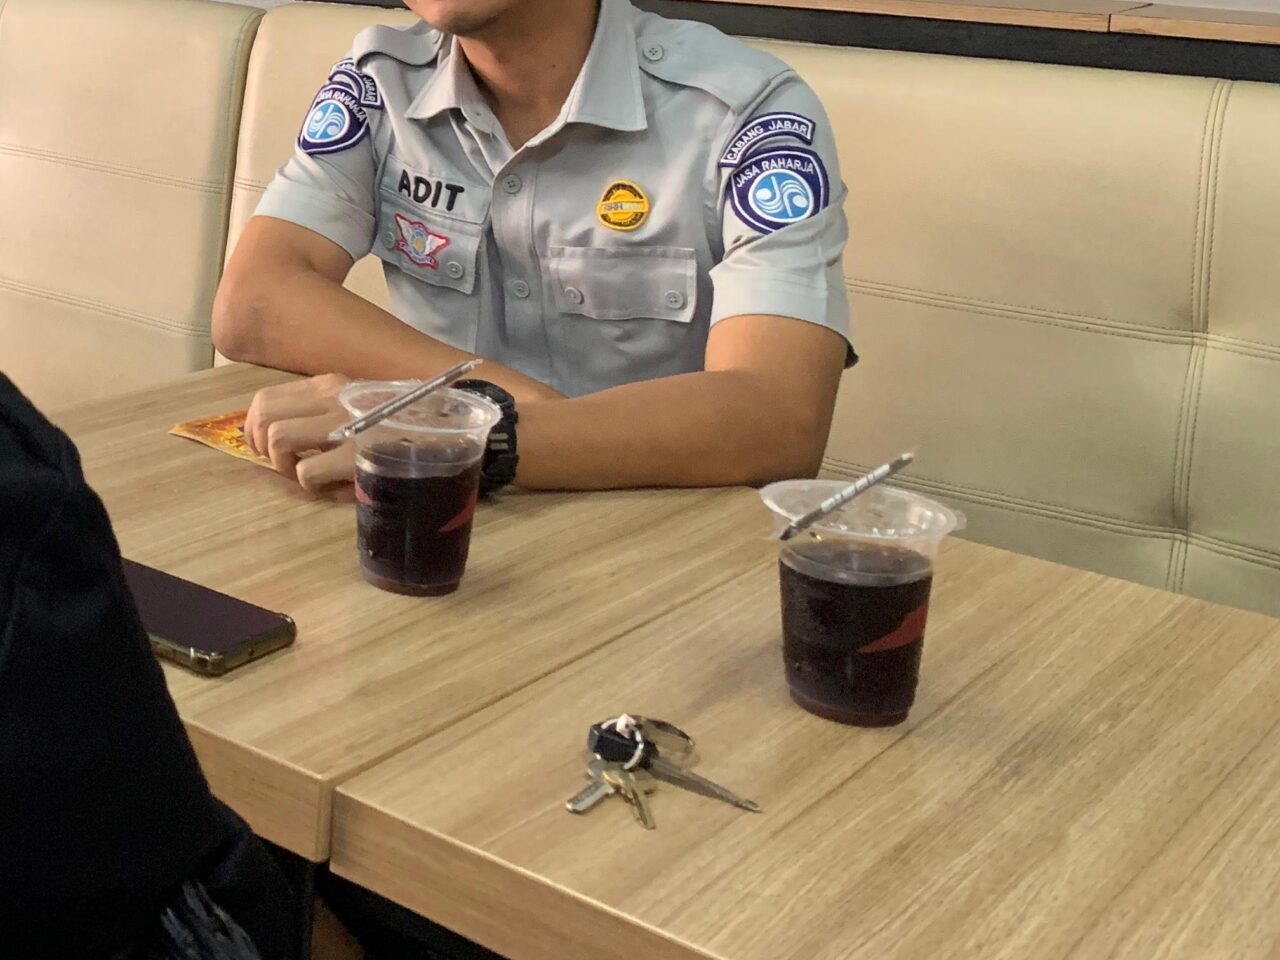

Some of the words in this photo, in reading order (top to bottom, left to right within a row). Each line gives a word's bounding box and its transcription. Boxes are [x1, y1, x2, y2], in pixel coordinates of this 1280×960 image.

[726, 125, 764, 161] CABANG
[768, 120, 808, 134] JABAR
[398, 168, 465, 211] ADIT
[736, 164, 761, 188] JASA
[761, 157, 814, 175] RAHARJA
